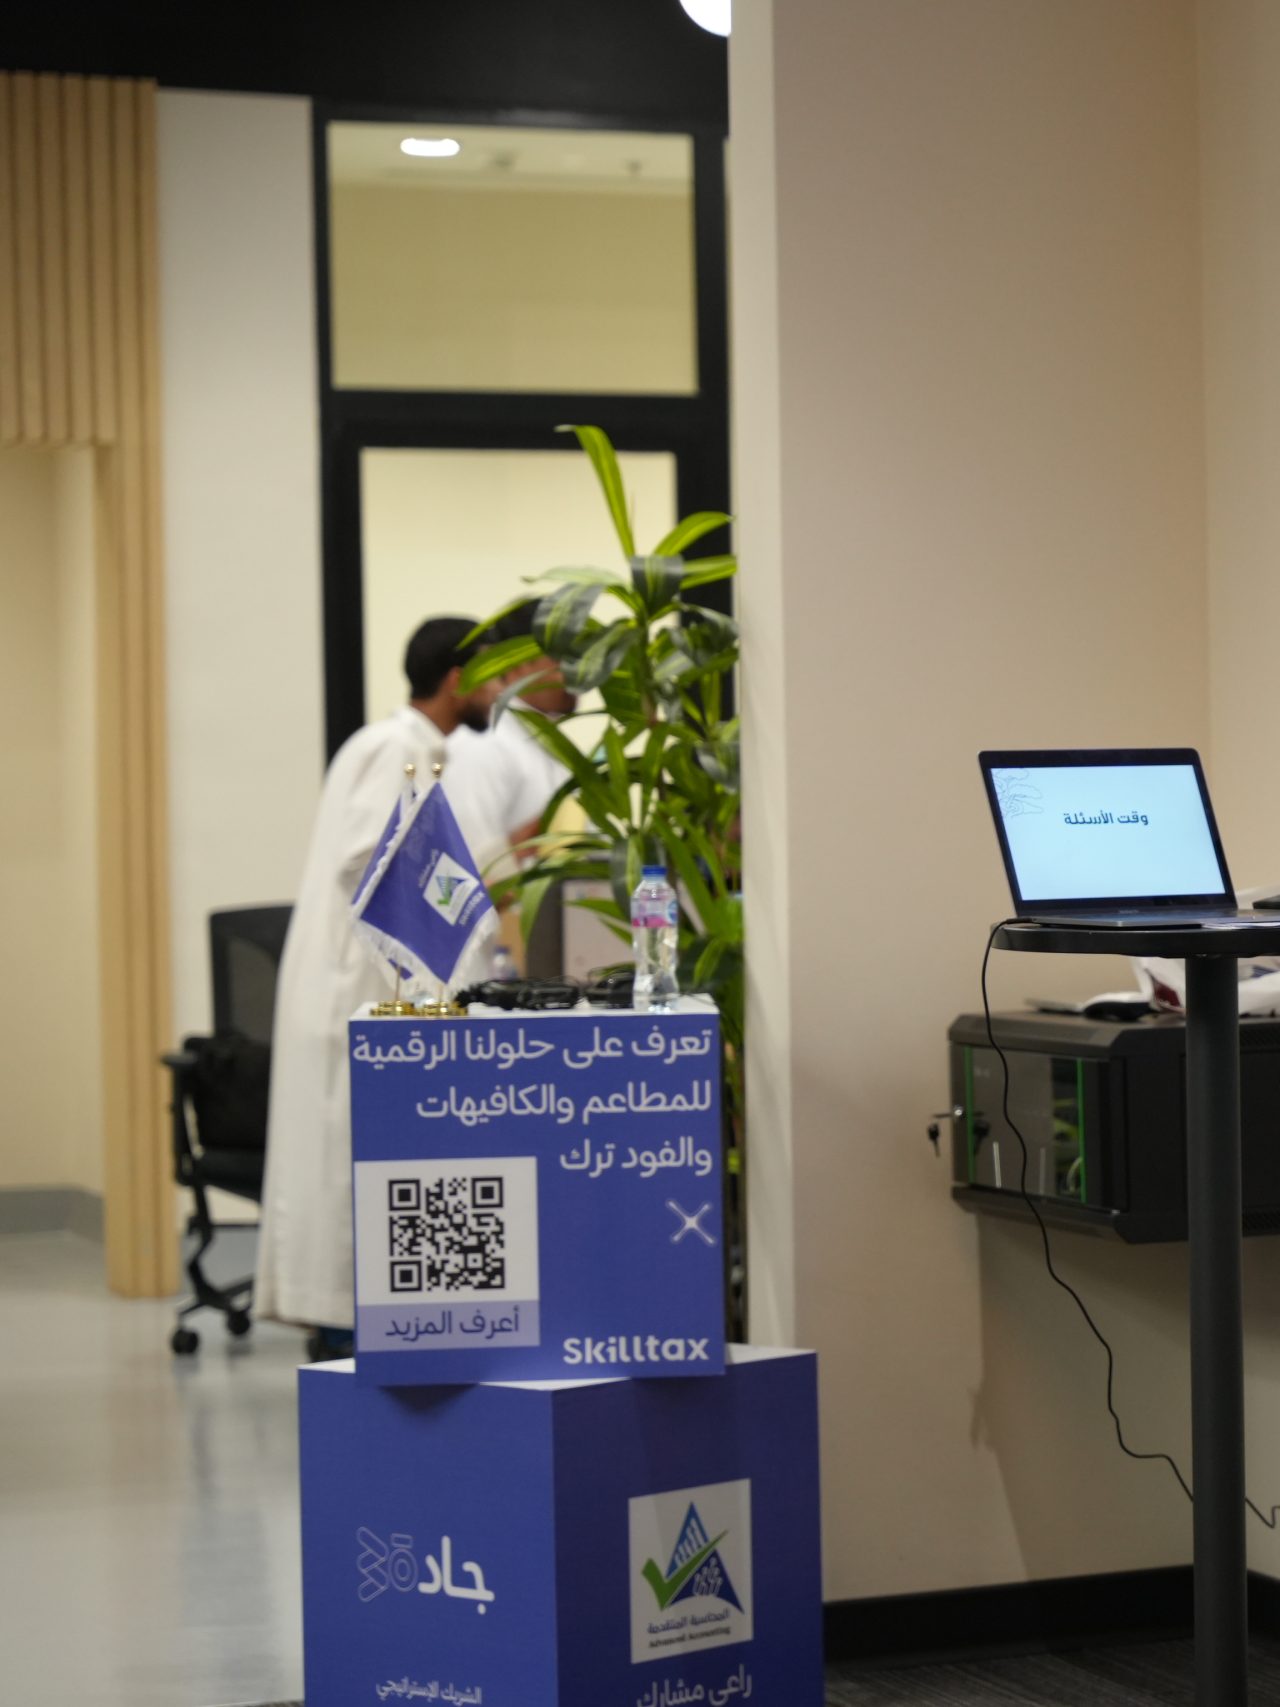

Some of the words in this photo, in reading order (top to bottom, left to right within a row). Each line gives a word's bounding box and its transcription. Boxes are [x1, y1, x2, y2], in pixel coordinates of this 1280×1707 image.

[1063, 809, 1114, 825] الأسئلة
[1117, 811, 1149, 825] وقت
[352, 1029, 457, 1070] الرقمية
[464, 1027, 556, 1069] حلولنا
[562, 1026, 624, 1069] على
[631, 1025, 713, 1065] تعرف
[415, 1083, 576, 1127] والكافيهات
[582, 1080, 712, 1124] للمطاعم
[559, 1138, 615, 1178] ترك
[620, 1136, 713, 1178] والفود
[385, 1310, 452, 1342] المزيد
[459, 1305, 521, 1340] أعرف
[562, 1334, 709, 1365] Skilltax
